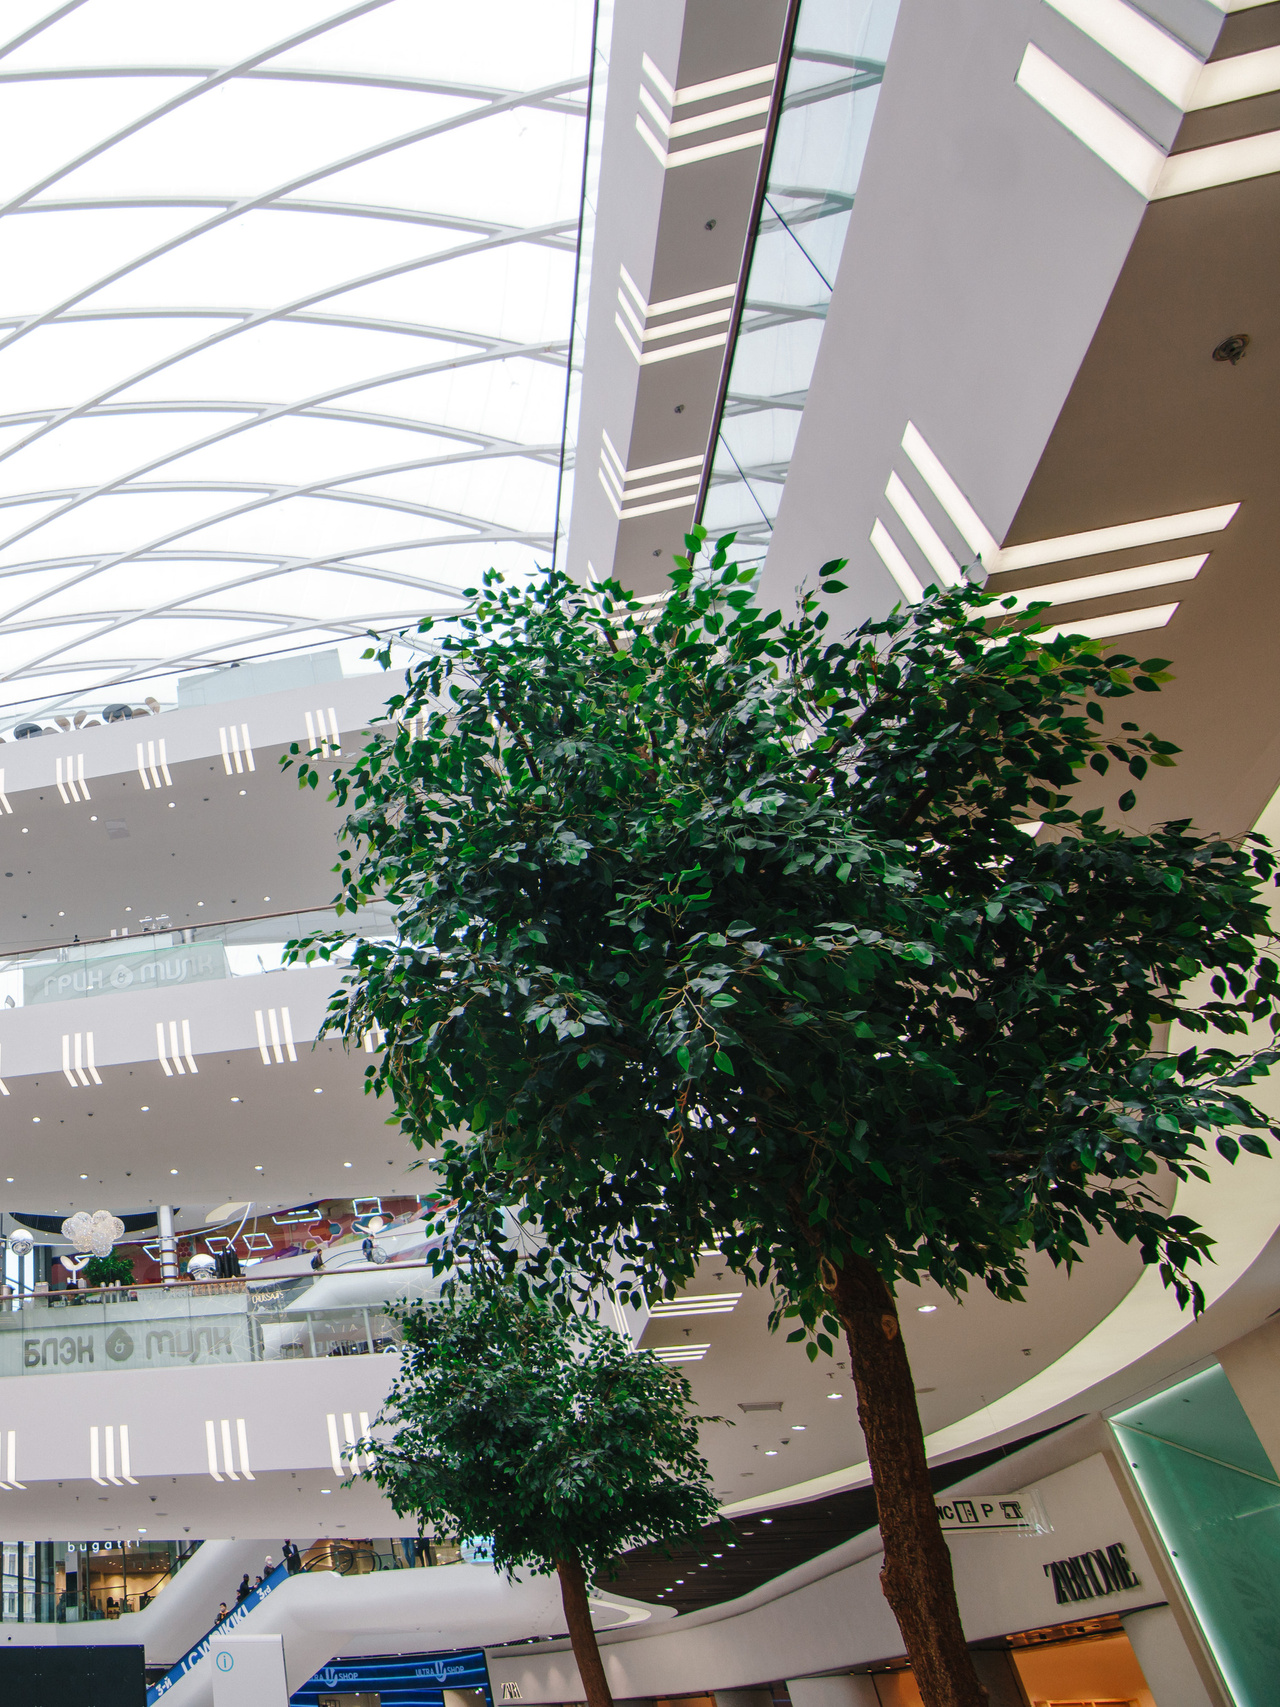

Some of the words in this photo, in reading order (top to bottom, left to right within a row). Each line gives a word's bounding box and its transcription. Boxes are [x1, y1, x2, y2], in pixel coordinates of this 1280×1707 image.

[981, 1503, 994, 1518] P
[67, 1540, 140, 1553] bugatti
[338, 1672, 358, 1680] SHOP
[415, 1668, 434, 1677] ULTRA
